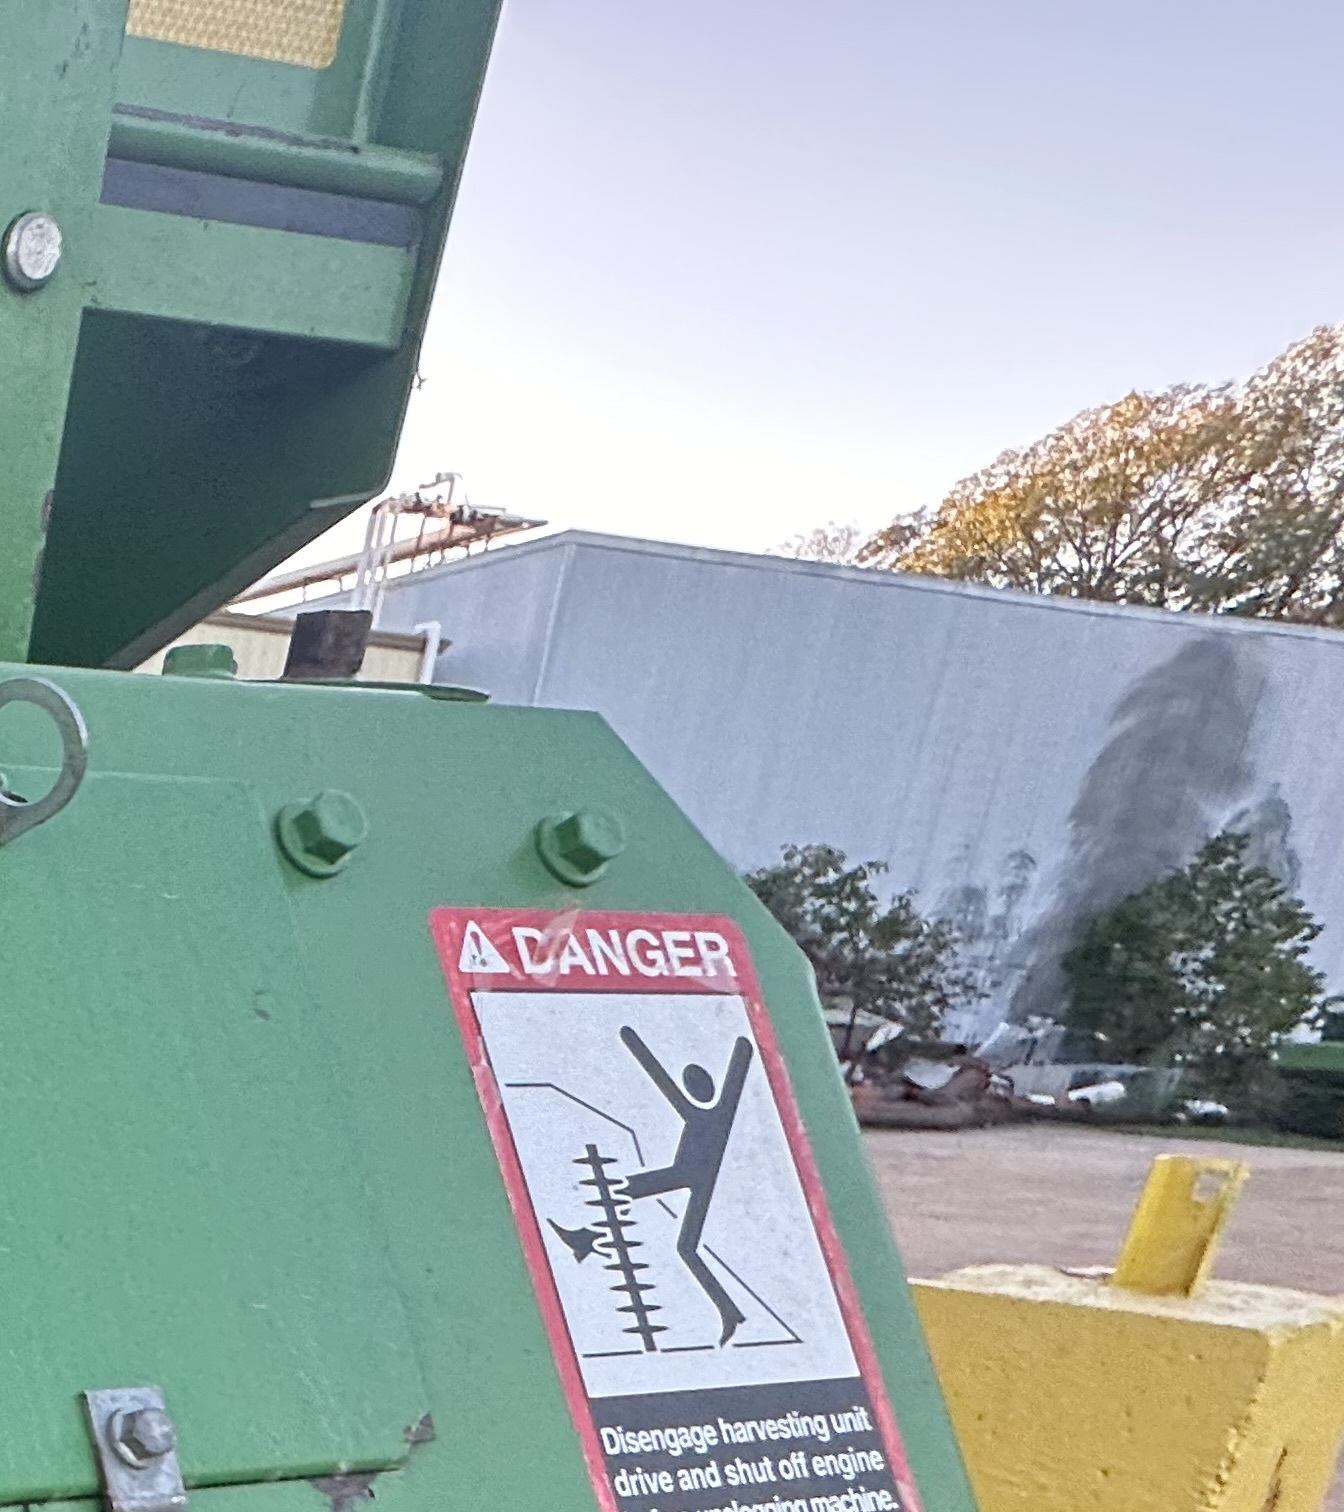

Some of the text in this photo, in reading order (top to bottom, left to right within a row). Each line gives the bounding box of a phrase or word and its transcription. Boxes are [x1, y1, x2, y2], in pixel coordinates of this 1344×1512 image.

[512, 927, 737, 977] DANGER
[600, 1406, 873, 1456] Disengage harvesting unit
[613, 1446, 885, 1498] drive and shut off engine
